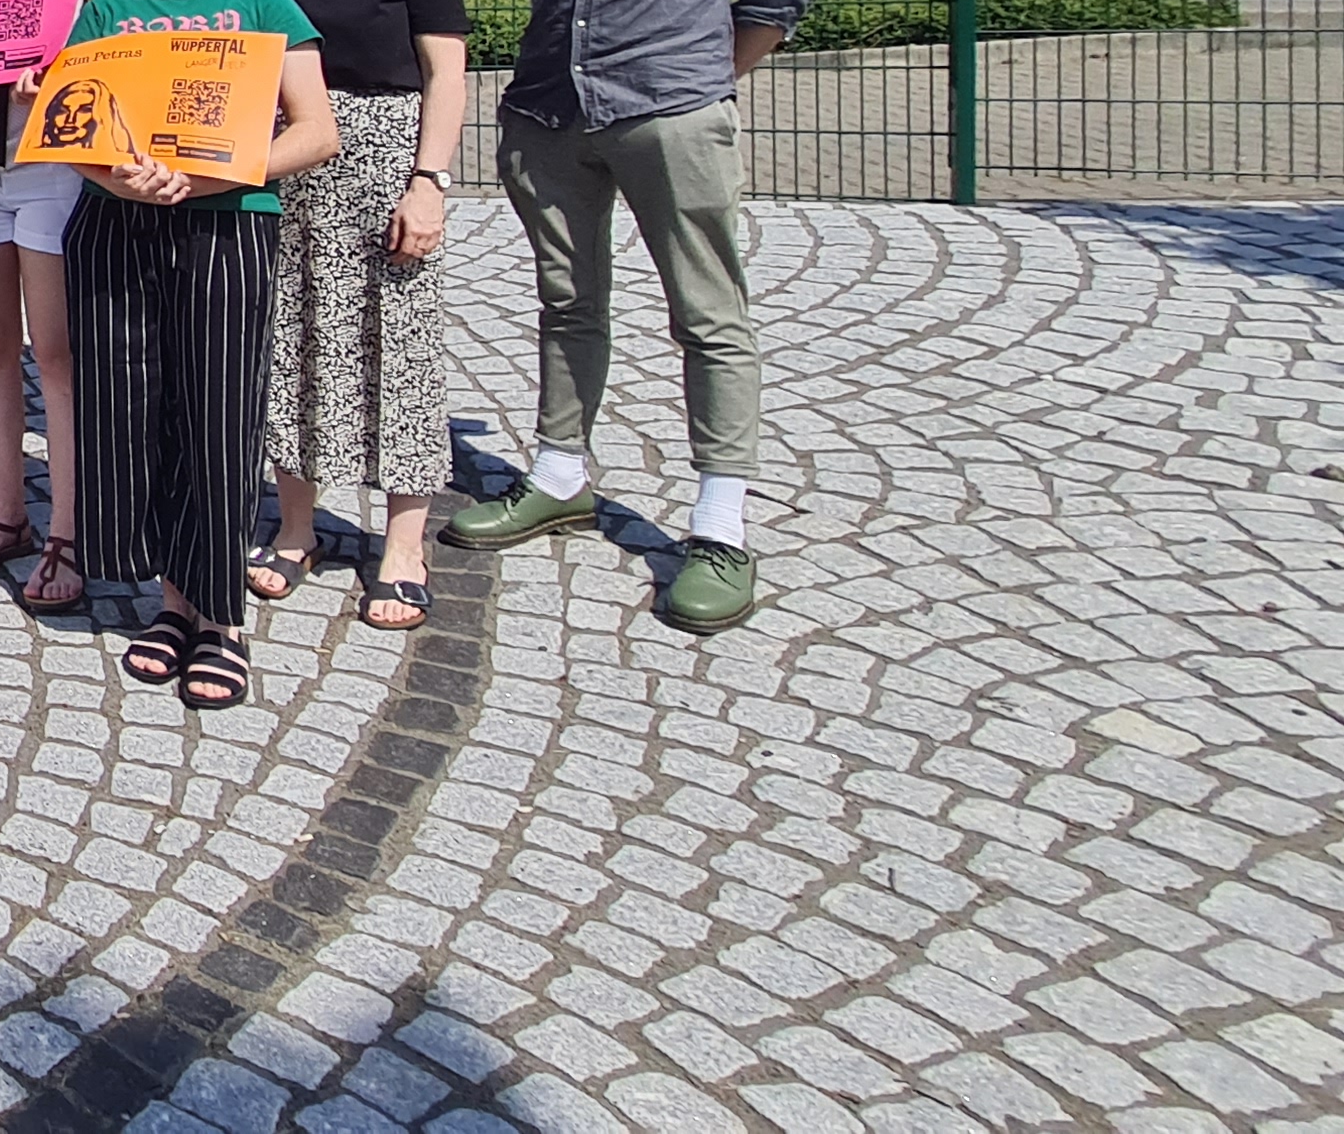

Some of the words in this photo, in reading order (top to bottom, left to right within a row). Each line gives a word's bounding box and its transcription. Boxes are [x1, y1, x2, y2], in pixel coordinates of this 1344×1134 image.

[62, 56, 90, 68] Kim
[92, 48, 142, 62] Petras
[170, 38, 246, 70] WUPPERTAL
